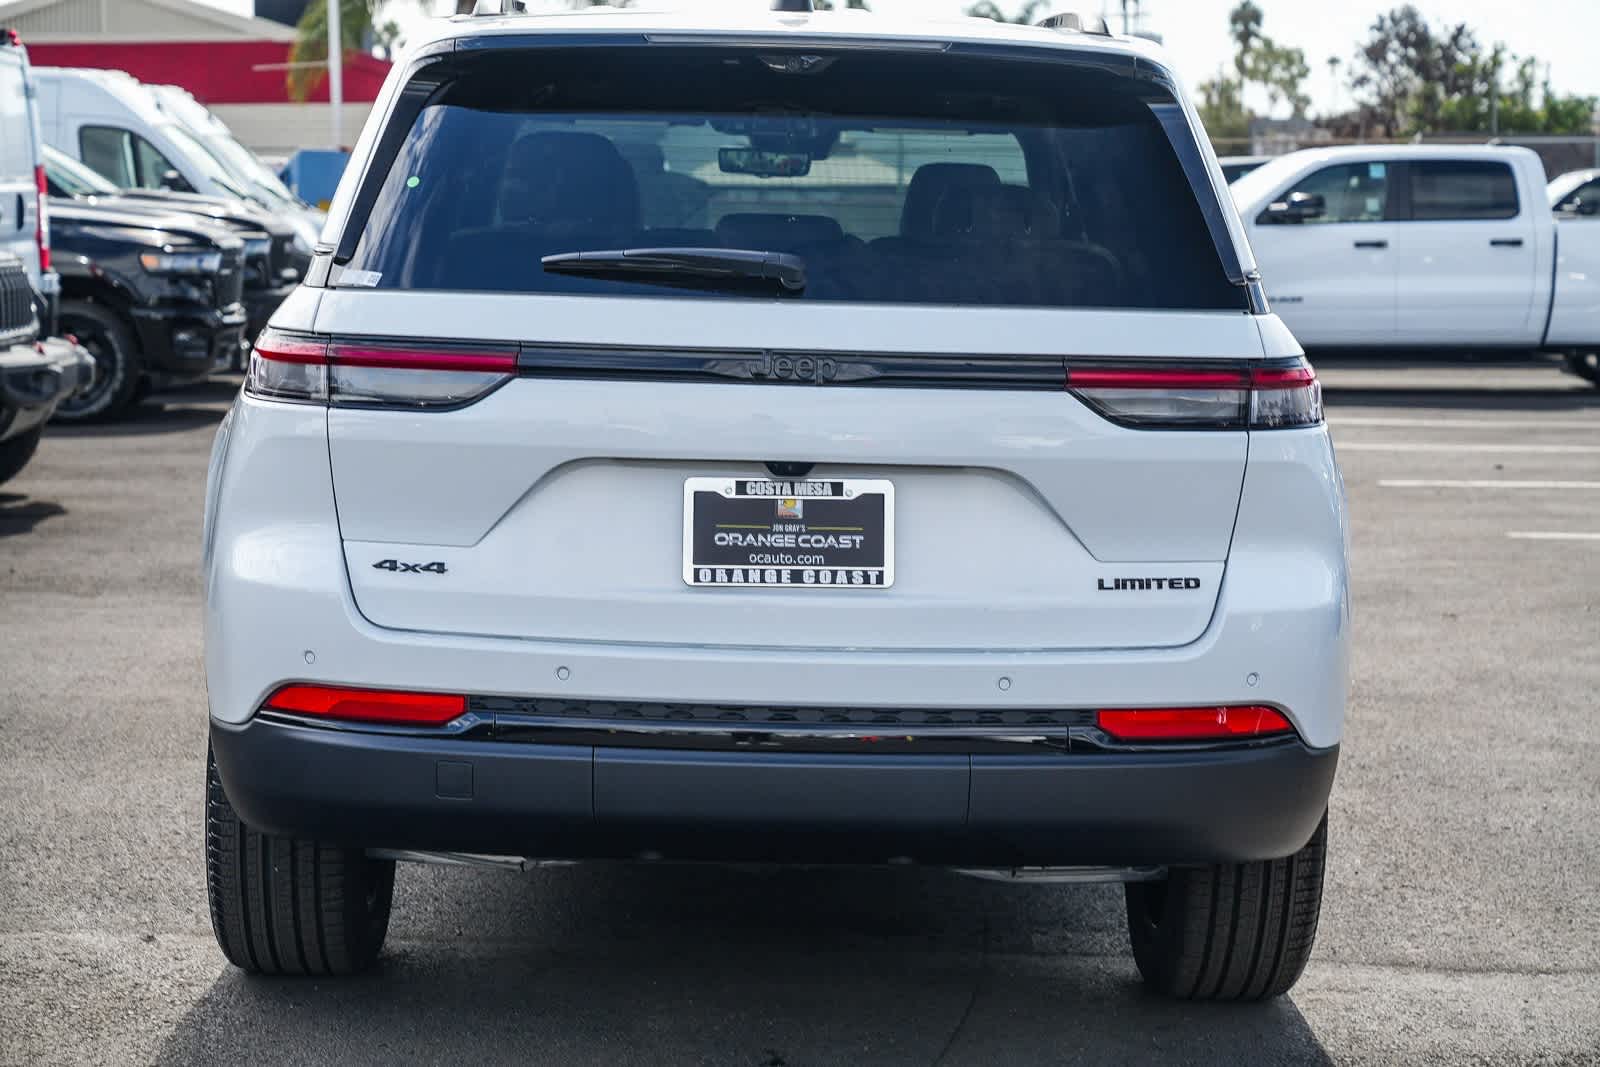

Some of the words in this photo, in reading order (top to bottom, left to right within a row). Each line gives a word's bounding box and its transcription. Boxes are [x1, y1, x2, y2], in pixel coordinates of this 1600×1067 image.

[749, 349, 837, 385] Jeep
[746, 481, 792, 496] COSTA
[795, 481, 832, 496] MESA
[714, 533, 796, 548] ORANGE
[798, 534, 864, 549] COAST
[372, 559, 448, 574] 4x4
[749, 552, 825, 566] ocauto.com
[699, 569, 791, 583] ORANGE
[803, 570, 880, 585] COAST
[1097, 577, 1201, 591] LIMITED
